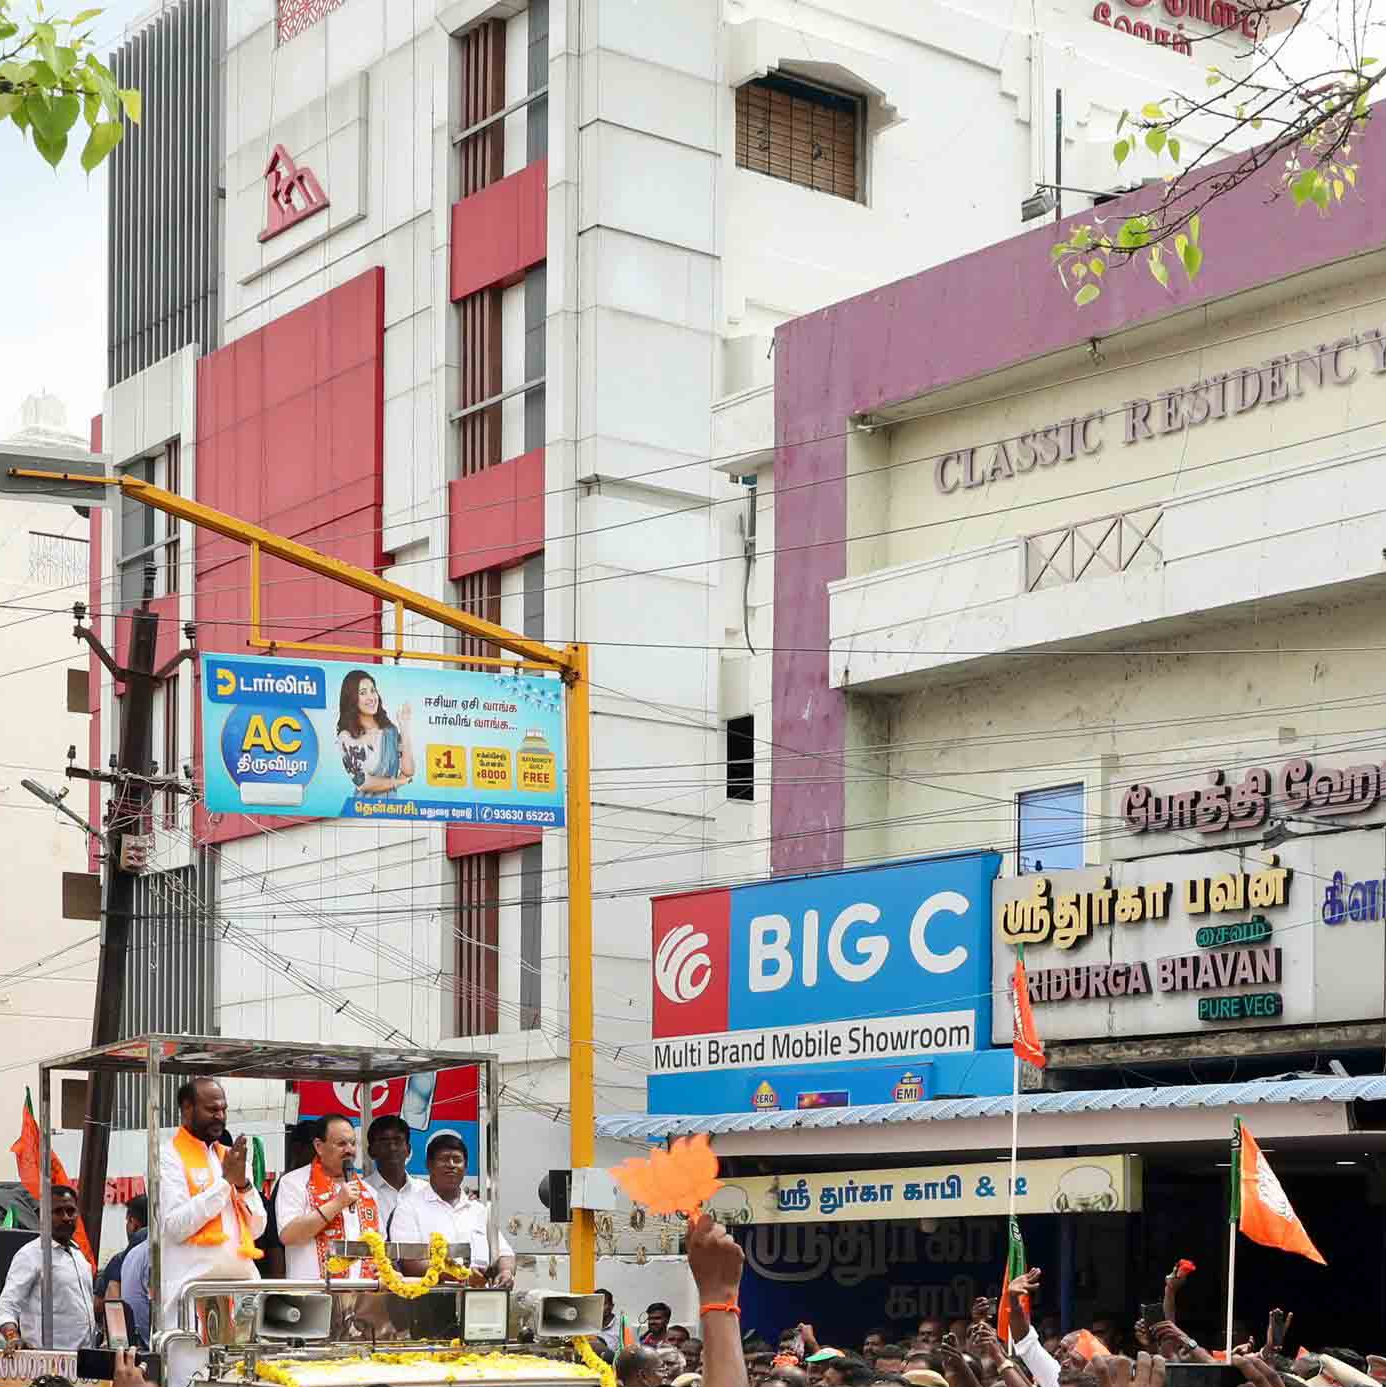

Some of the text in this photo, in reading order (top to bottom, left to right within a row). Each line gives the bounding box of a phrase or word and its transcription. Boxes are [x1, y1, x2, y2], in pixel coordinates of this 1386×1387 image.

[933, 409, 1107, 495] CLASSIC
[240, 673, 317, 696] டார்லிங்
[428, 713, 471, 727] டார்லிங்
[483, 698, 517, 713] வாங்க
[242, 714, 302, 755] AC
[236, 752, 309, 777] திருவிழா
[523, 771, 550, 784] FREE
[492, 808, 524, 821] 93630
[525, 811, 556, 822] 65223
[1120, 766, 1272, 834] போத்தி
[1183, 854, 1294, 914] பவன்
[748, 891, 970, 993] BIG C
[1157, 947, 1282, 993] BHAVAN
[1199, 998, 1241, 1019] PURE
[654, 1024, 970, 1070] Multi Brand Mobile Showroom
[896, 1088, 918, 1100] EMI
[819, 1180, 894, 1214] துர்கா
[903, 1173, 963, 1203] காபி
[975, 1175, 996, 1198] &
